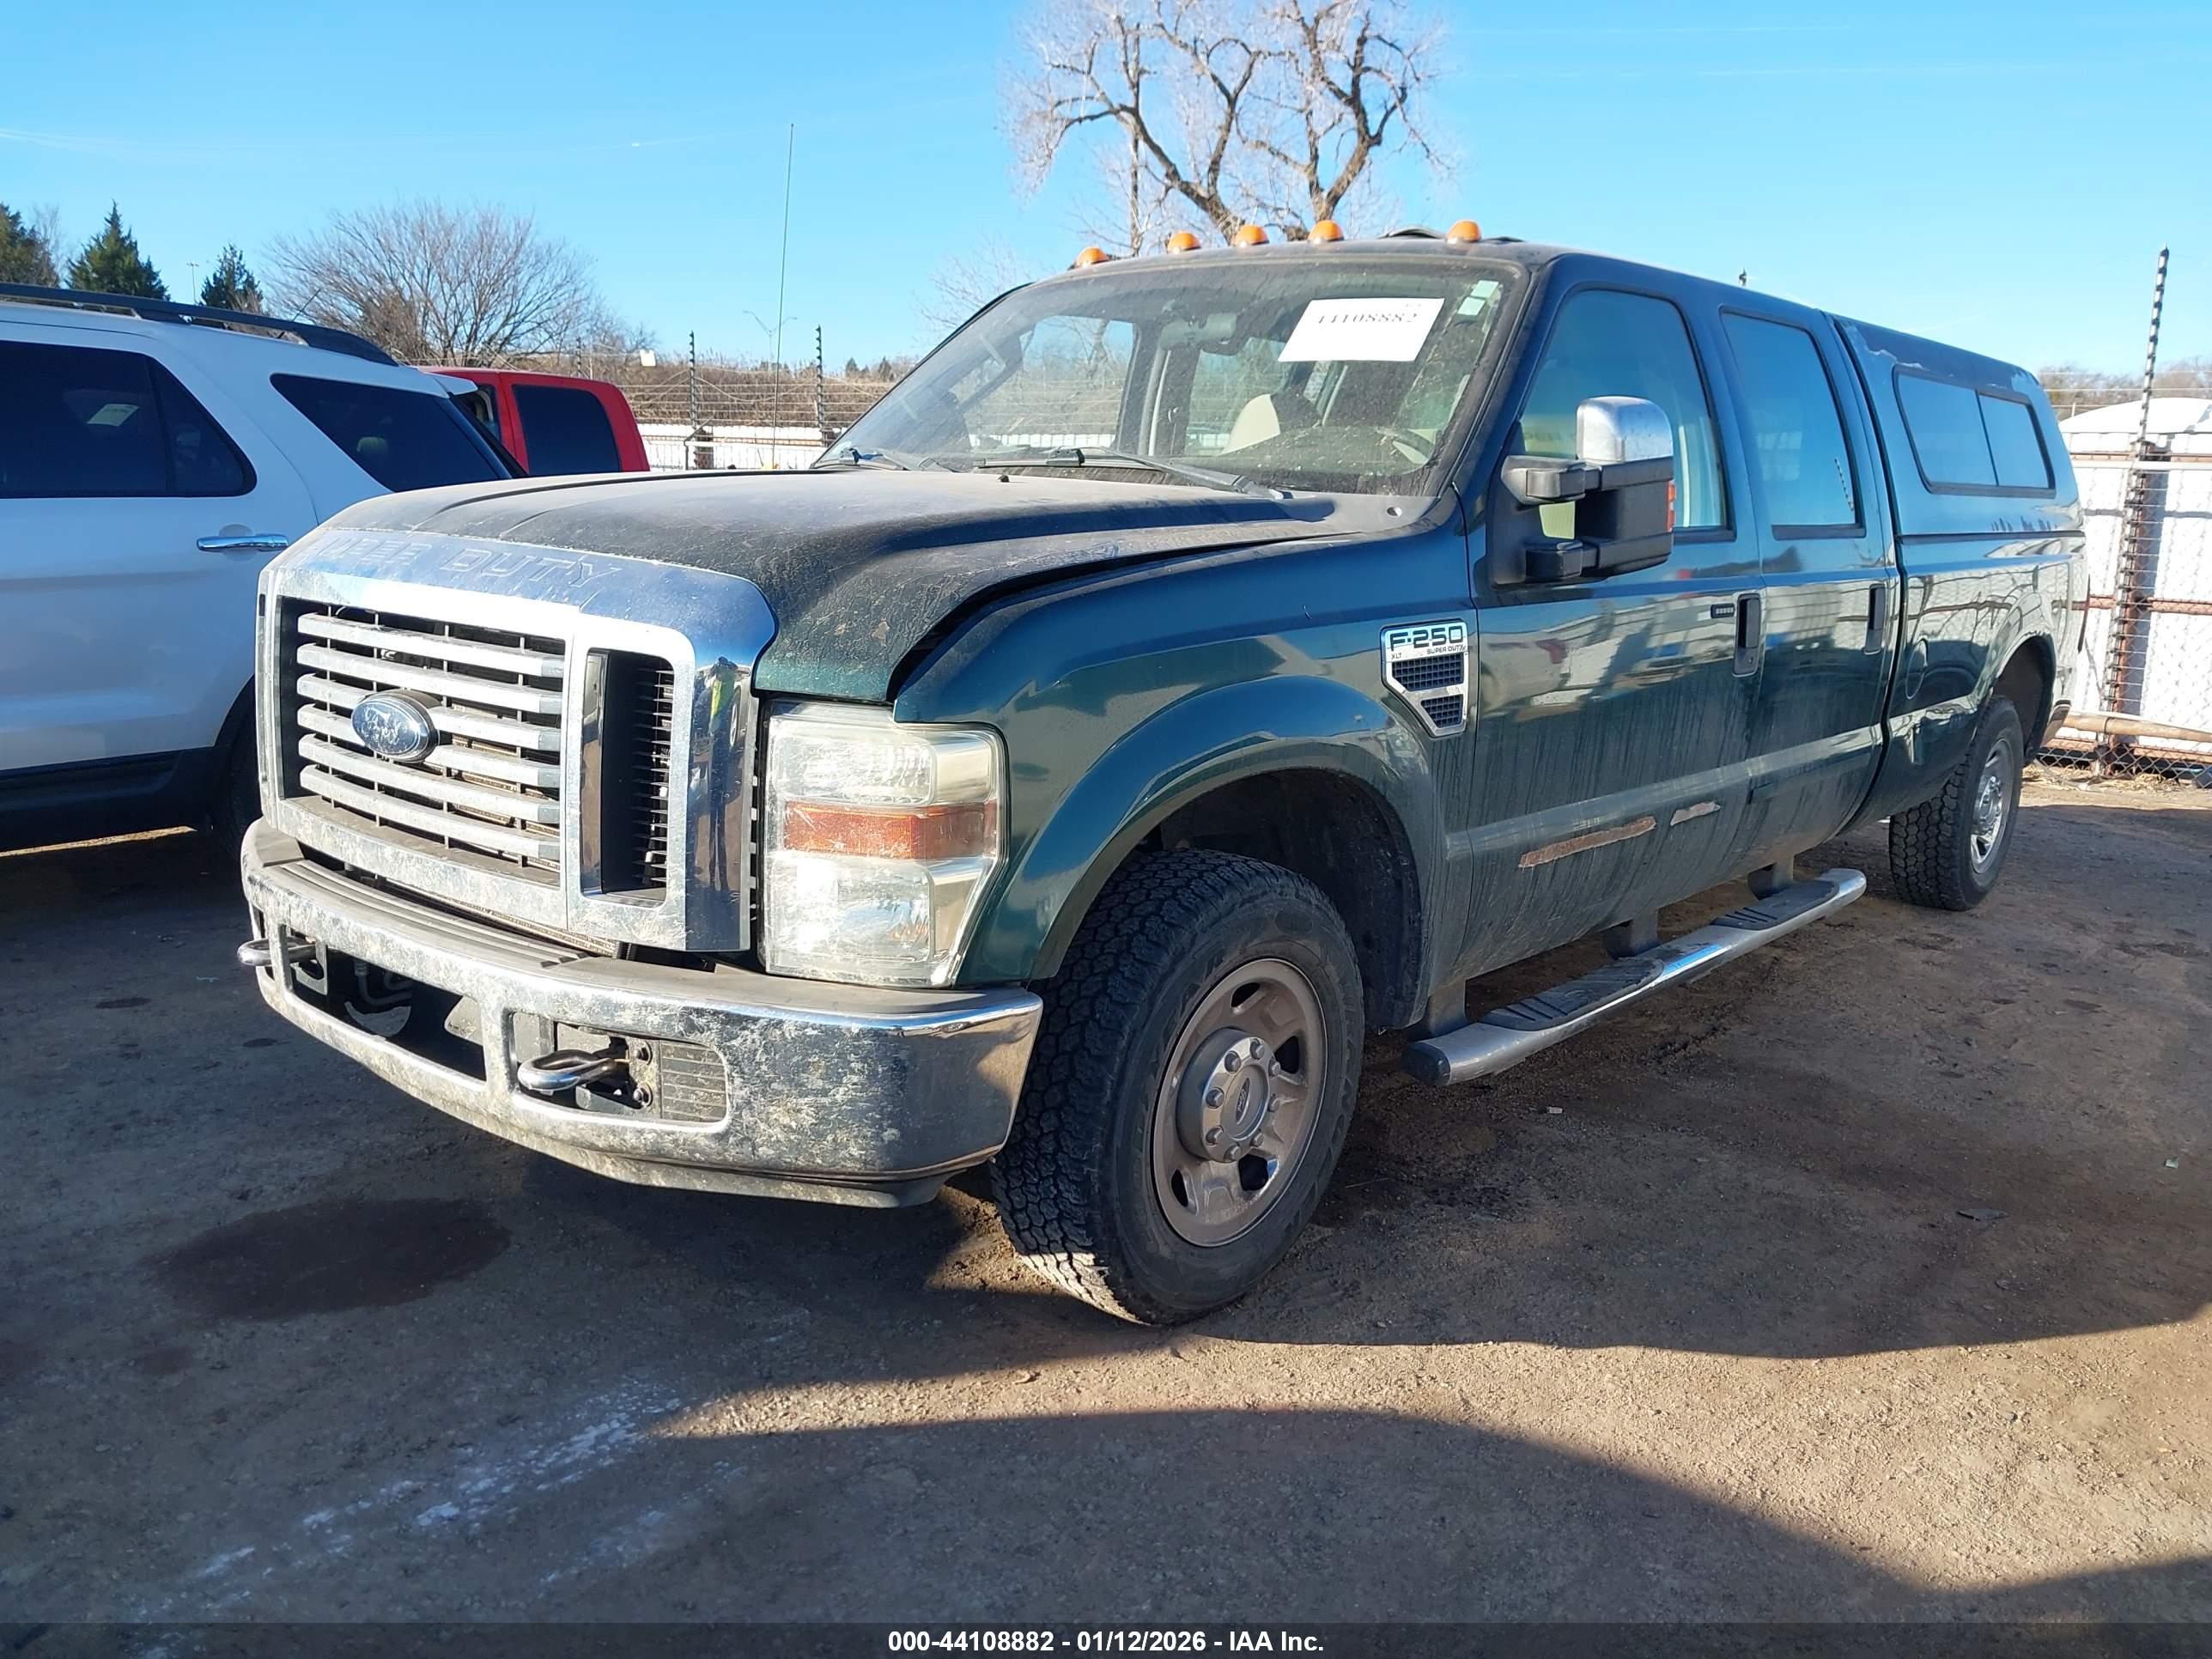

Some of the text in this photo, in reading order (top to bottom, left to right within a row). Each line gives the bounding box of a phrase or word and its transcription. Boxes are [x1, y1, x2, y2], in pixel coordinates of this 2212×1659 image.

[302, 536, 623, 589] UPER DUTY
[1389, 625, 1464, 652] F-250
[1391, 652, 1402, 660] XLT
[1426, 644, 1467, 655] SUPER DUTY
